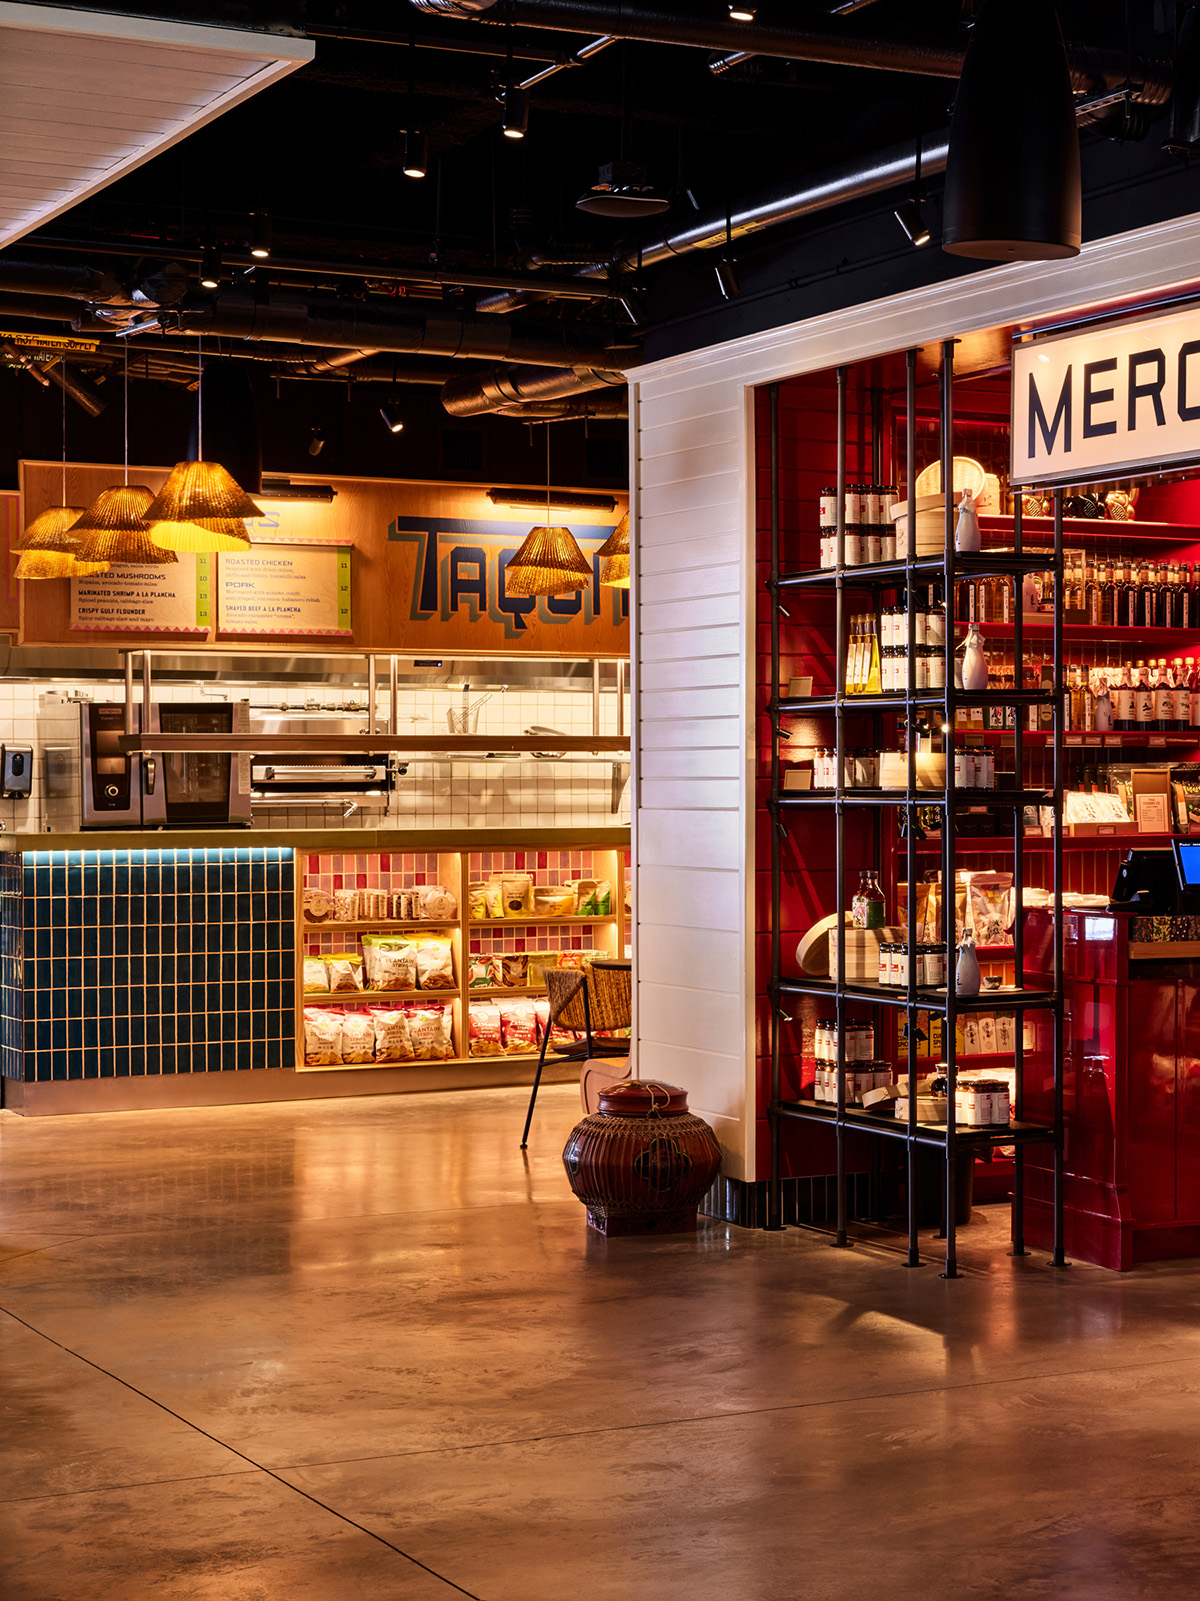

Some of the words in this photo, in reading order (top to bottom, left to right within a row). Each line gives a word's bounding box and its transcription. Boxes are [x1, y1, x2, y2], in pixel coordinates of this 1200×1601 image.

[225, 558, 260, 566] ROASTED
[116, 572, 166, 580] MUSHROOMS
[410, 1026, 440, 1034] PLANTAIN
